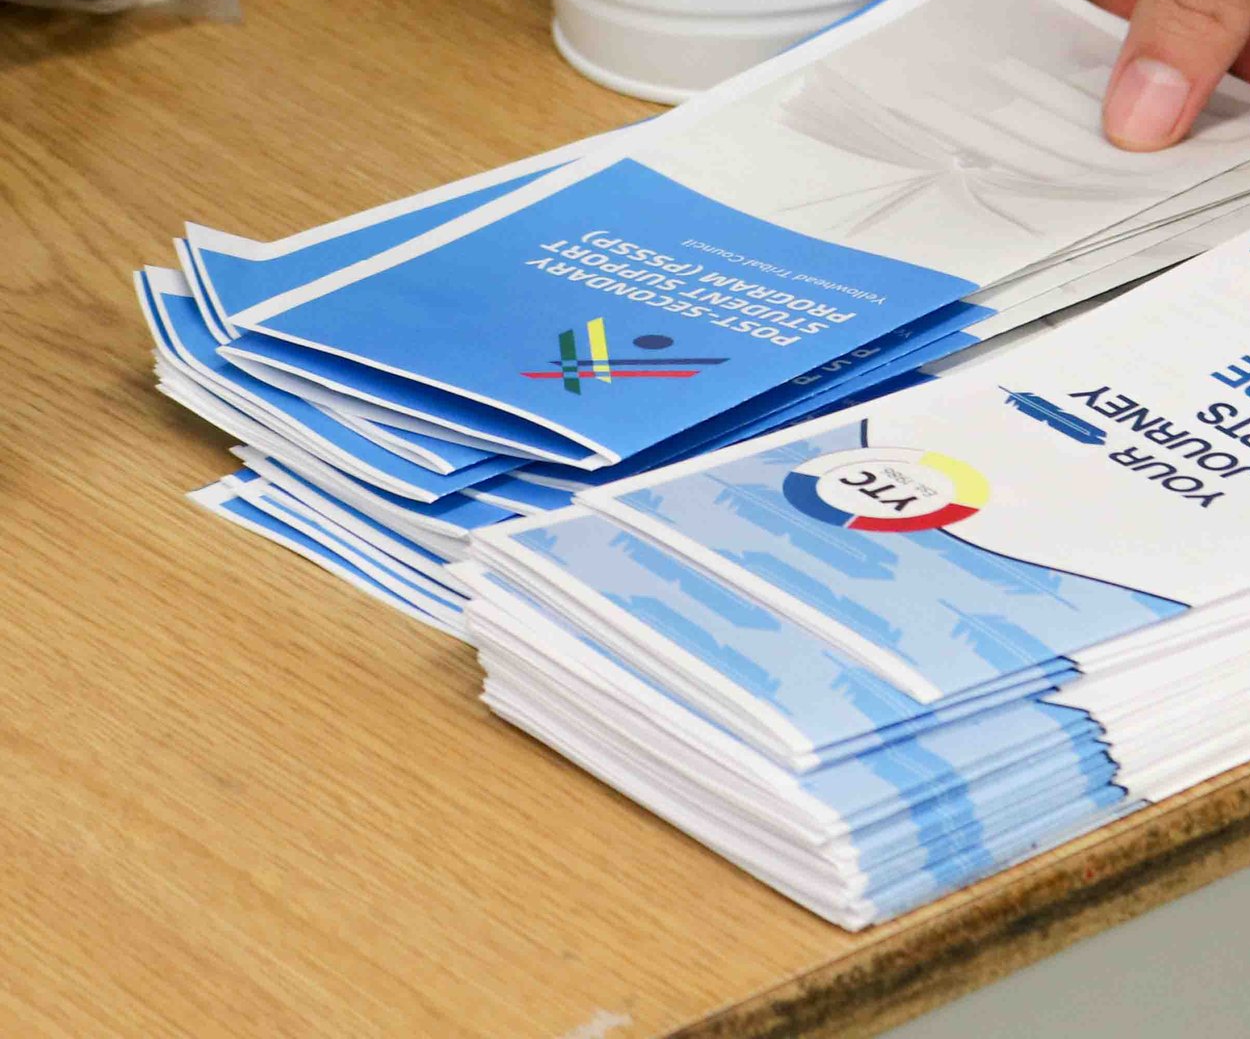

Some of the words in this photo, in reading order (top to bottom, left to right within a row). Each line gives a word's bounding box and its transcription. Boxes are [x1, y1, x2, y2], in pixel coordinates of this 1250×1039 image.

[540, 239, 686, 292] SUPPORT
[581, 230, 704, 277] (PSSSP)
[681, 239, 738, 263] Council
[742, 259, 793, 280] Tribal
[525, 257, 802, 347] POST-SECONDARY
[679, 287, 830, 335] STUDENT
[700, 271, 857, 324] PROGRAM
[795, 274, 887, 306] Yellowhead
[839, 471, 918, 511] YTC
[1108, 446, 1225, 508] YOUR
